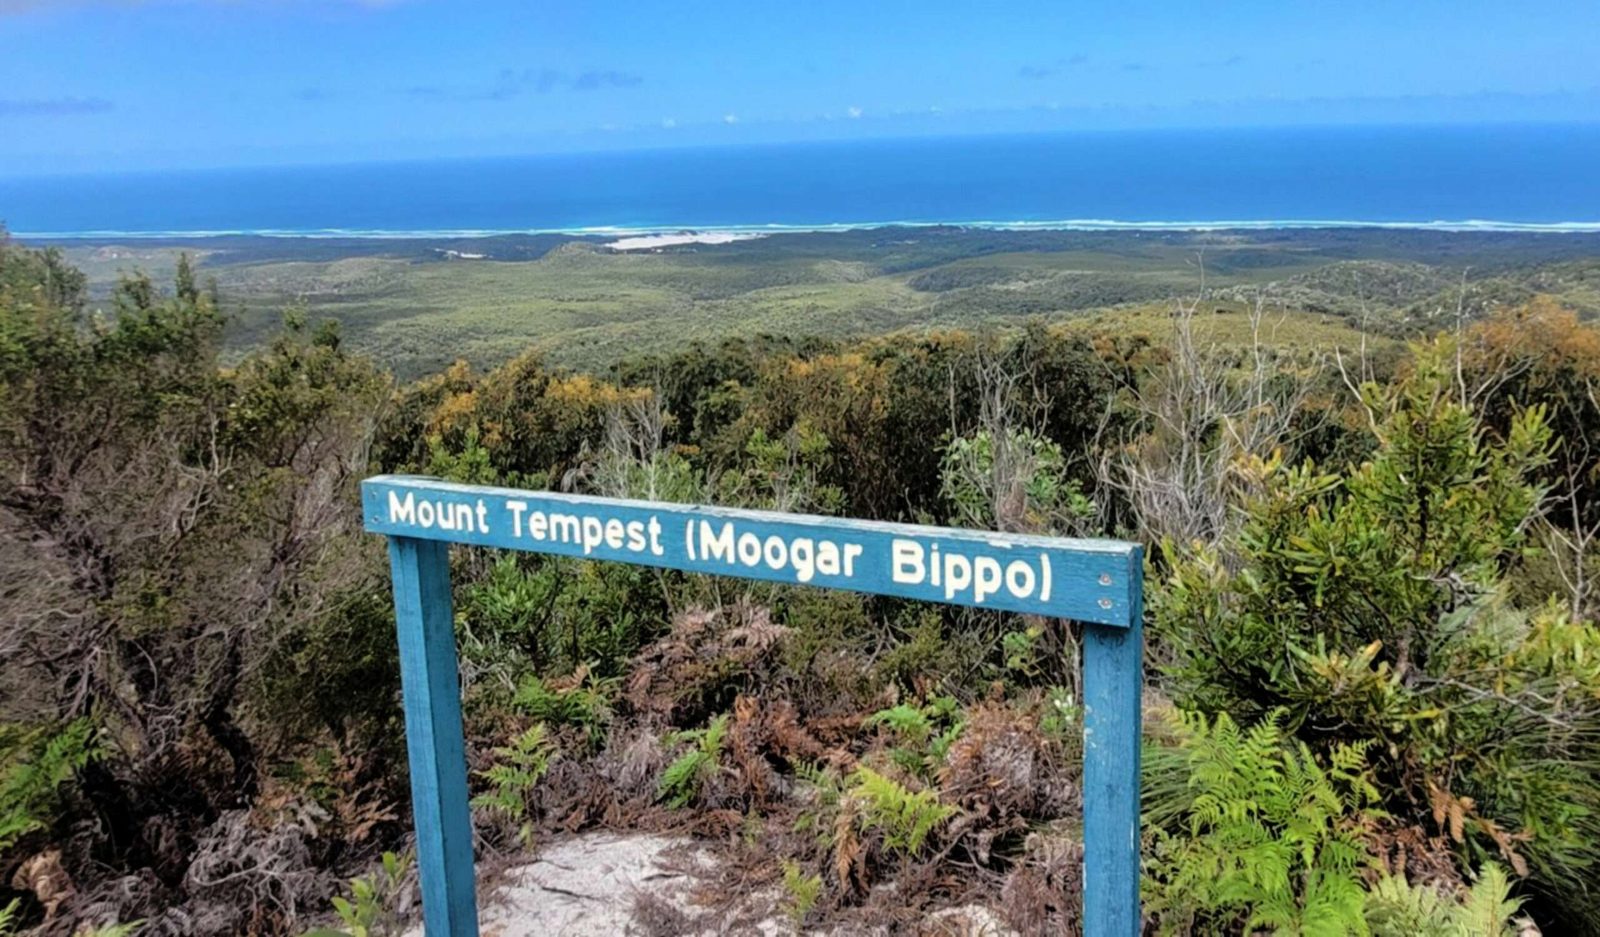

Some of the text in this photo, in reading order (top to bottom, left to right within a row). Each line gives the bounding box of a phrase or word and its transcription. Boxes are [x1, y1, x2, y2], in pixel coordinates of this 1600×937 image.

[388, 490, 1052, 602] Mount Tempest (Moogar Bippo)
